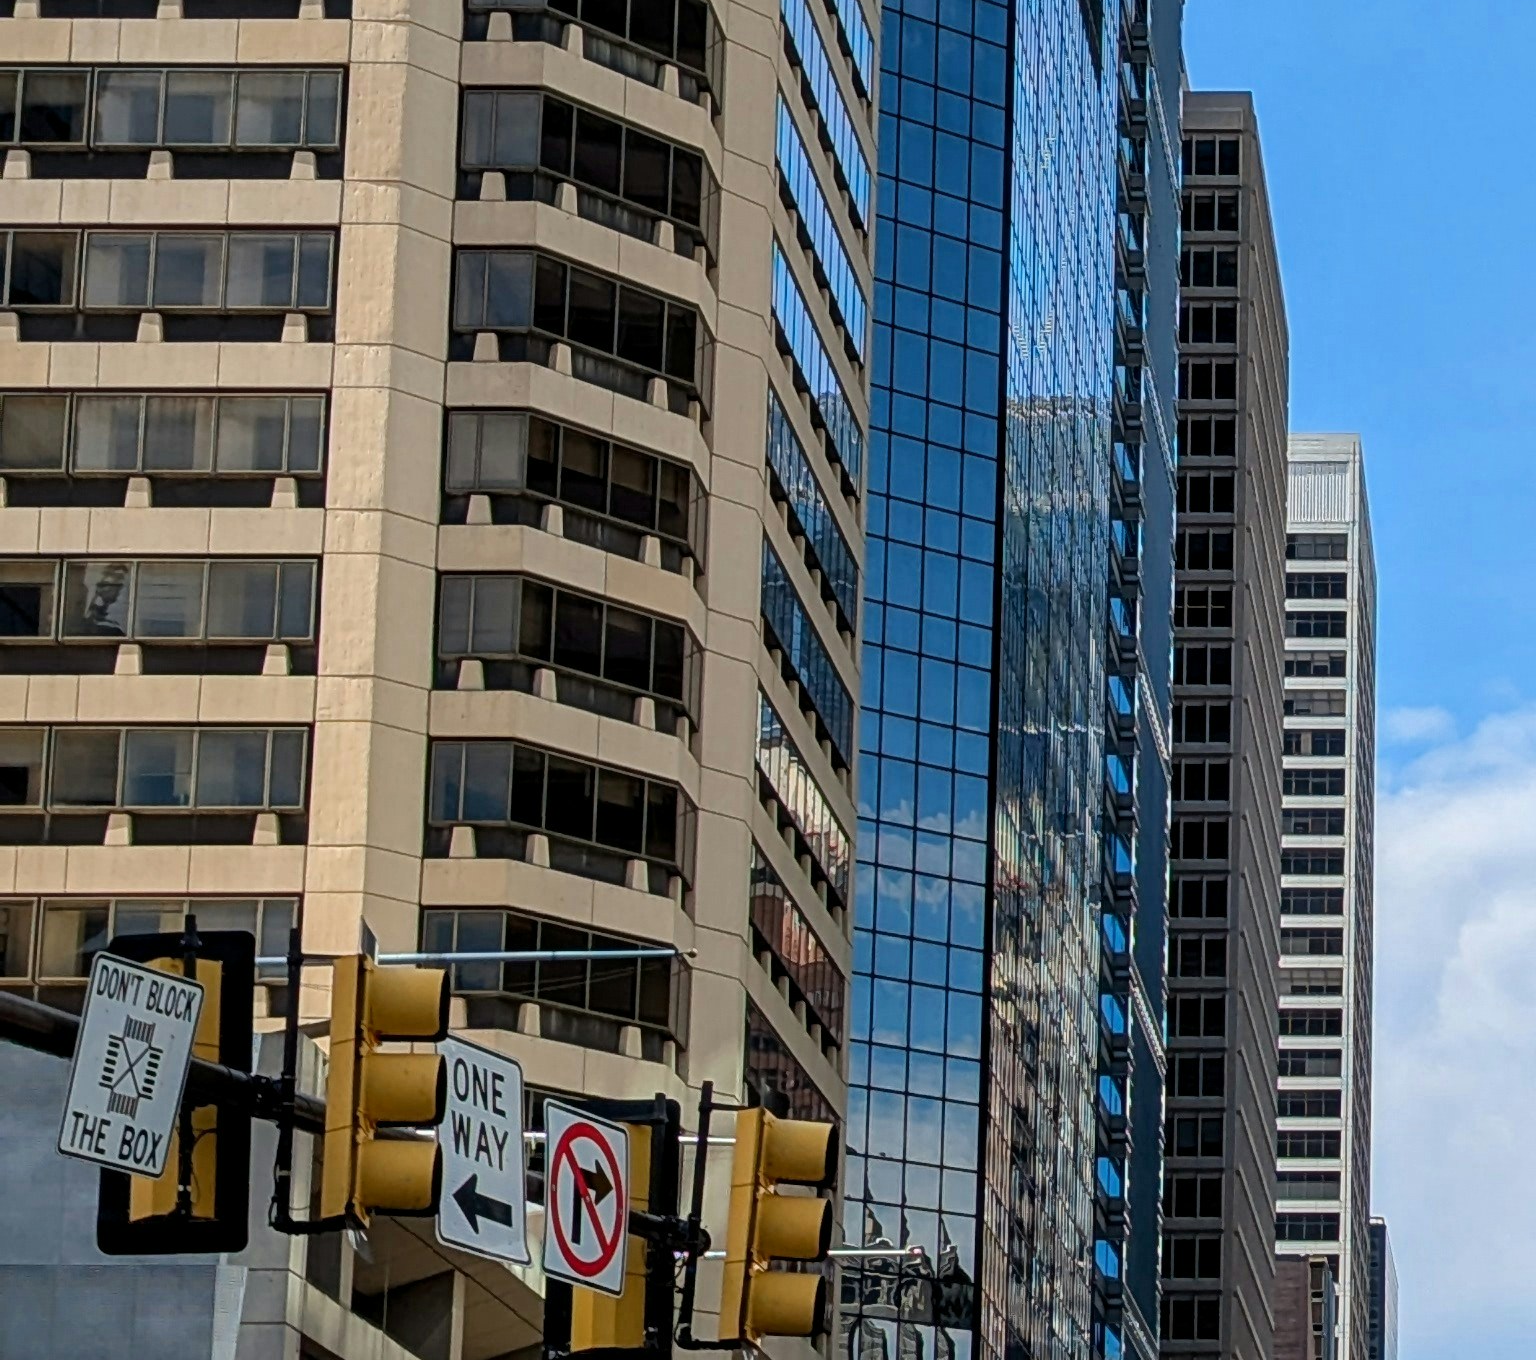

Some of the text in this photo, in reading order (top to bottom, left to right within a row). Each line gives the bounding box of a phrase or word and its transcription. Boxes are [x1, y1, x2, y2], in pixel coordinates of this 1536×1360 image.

[96, 964, 197, 1022] DON'T BLOCK
[453, 1058, 507, 1119] ONE
[69, 1111, 163, 1169] THE BOX
[451, 1110, 508, 1171] WAY
